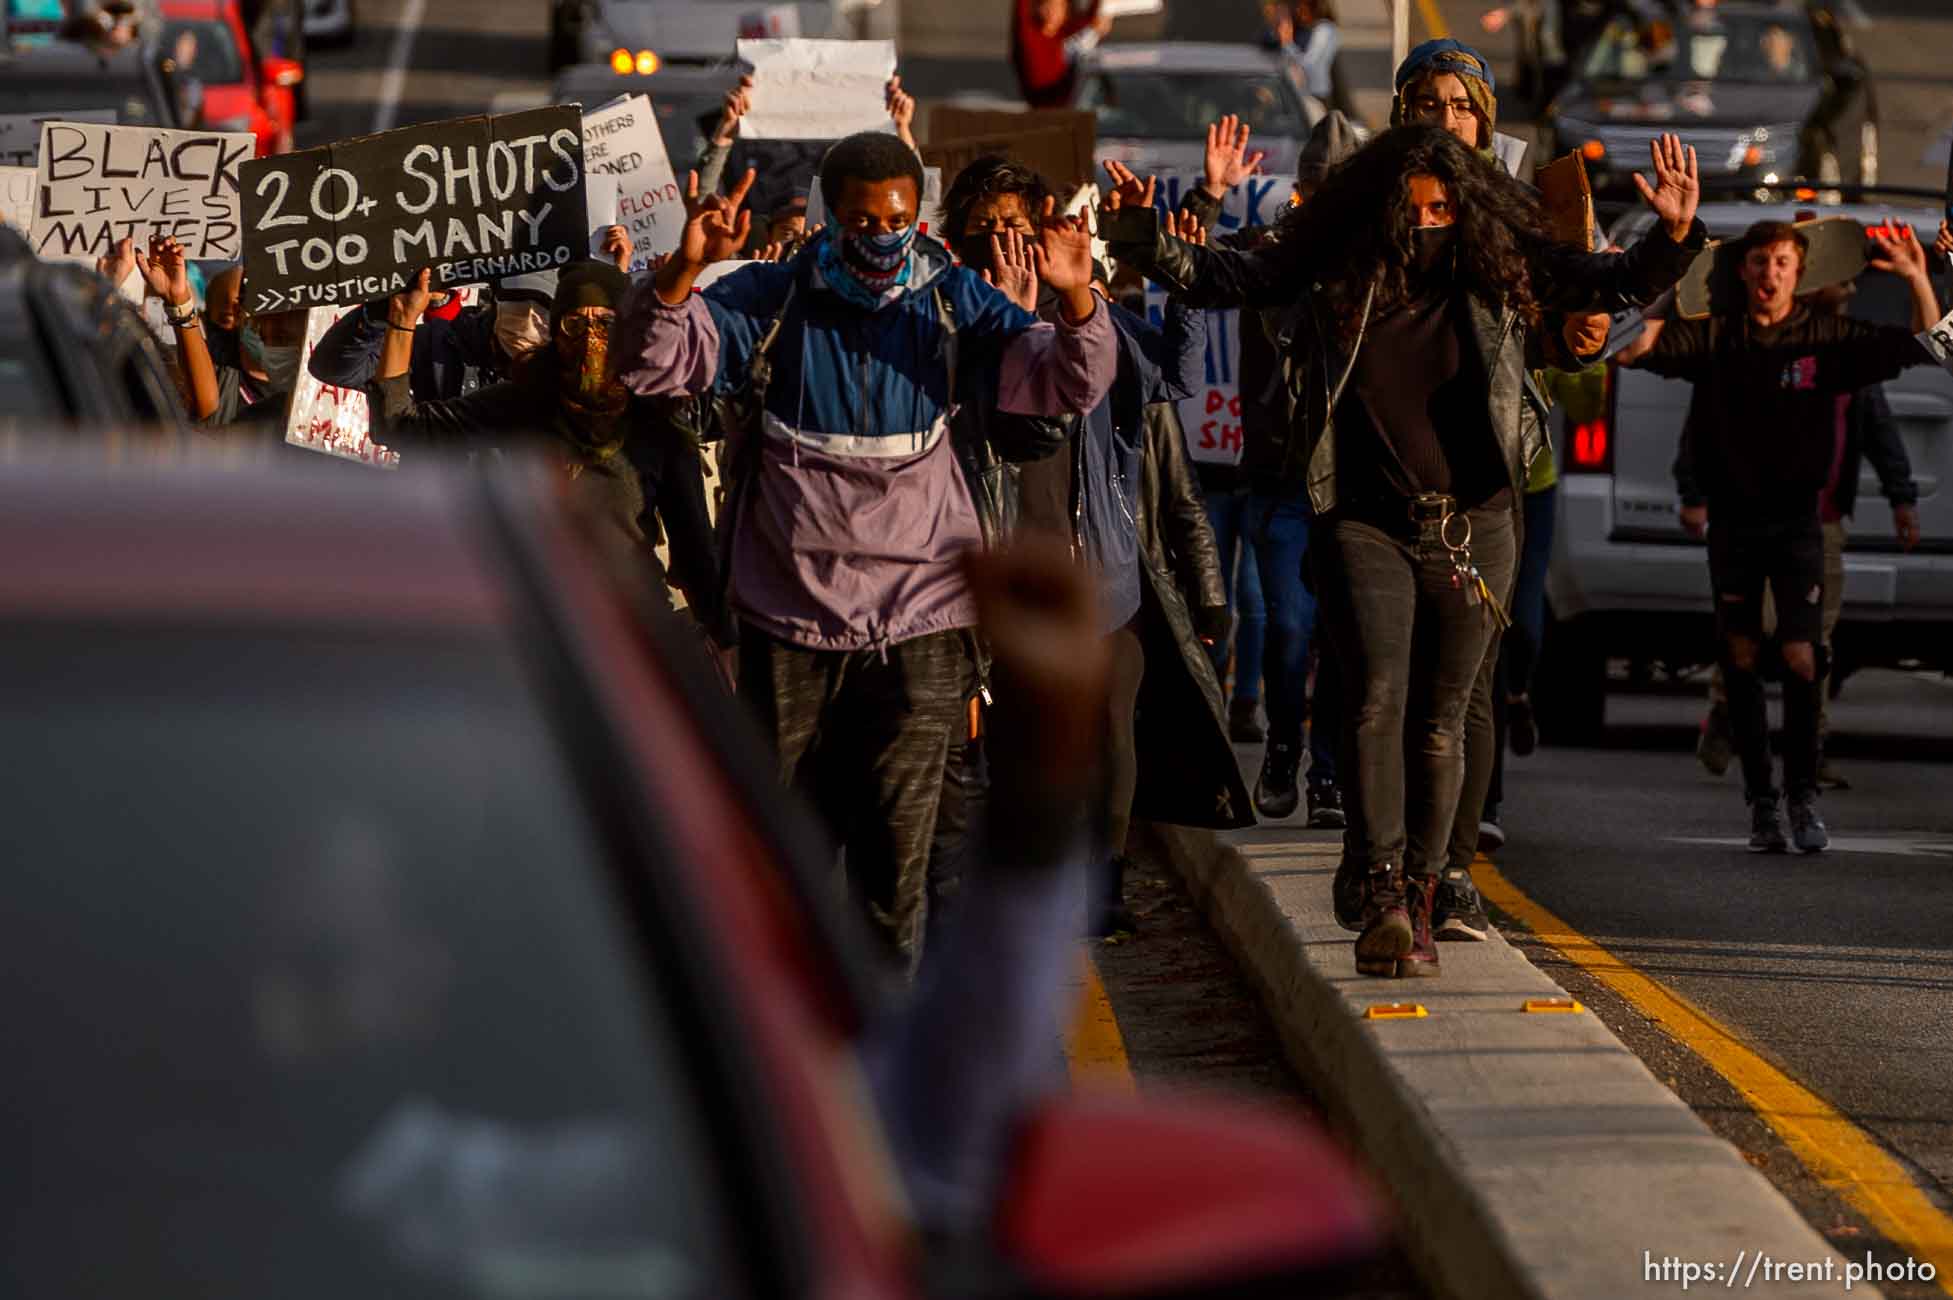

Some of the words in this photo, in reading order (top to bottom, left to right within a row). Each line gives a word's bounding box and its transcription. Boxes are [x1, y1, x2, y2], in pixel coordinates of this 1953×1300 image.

[46, 126, 249, 196] BLACK
[254, 165, 378, 231] 20+
[396, 128, 579, 214] SHOTS
[40, 185, 232, 219] LIVES
[619, 183, 678, 217] FLOYD
[632, 212, 657, 233] OUT
[265, 234, 368, 275] TOO
[393, 203, 552, 264] MANY
[288, 271, 407, 305] JUSTICIA
[436, 246, 571, 283] BERNARDO
